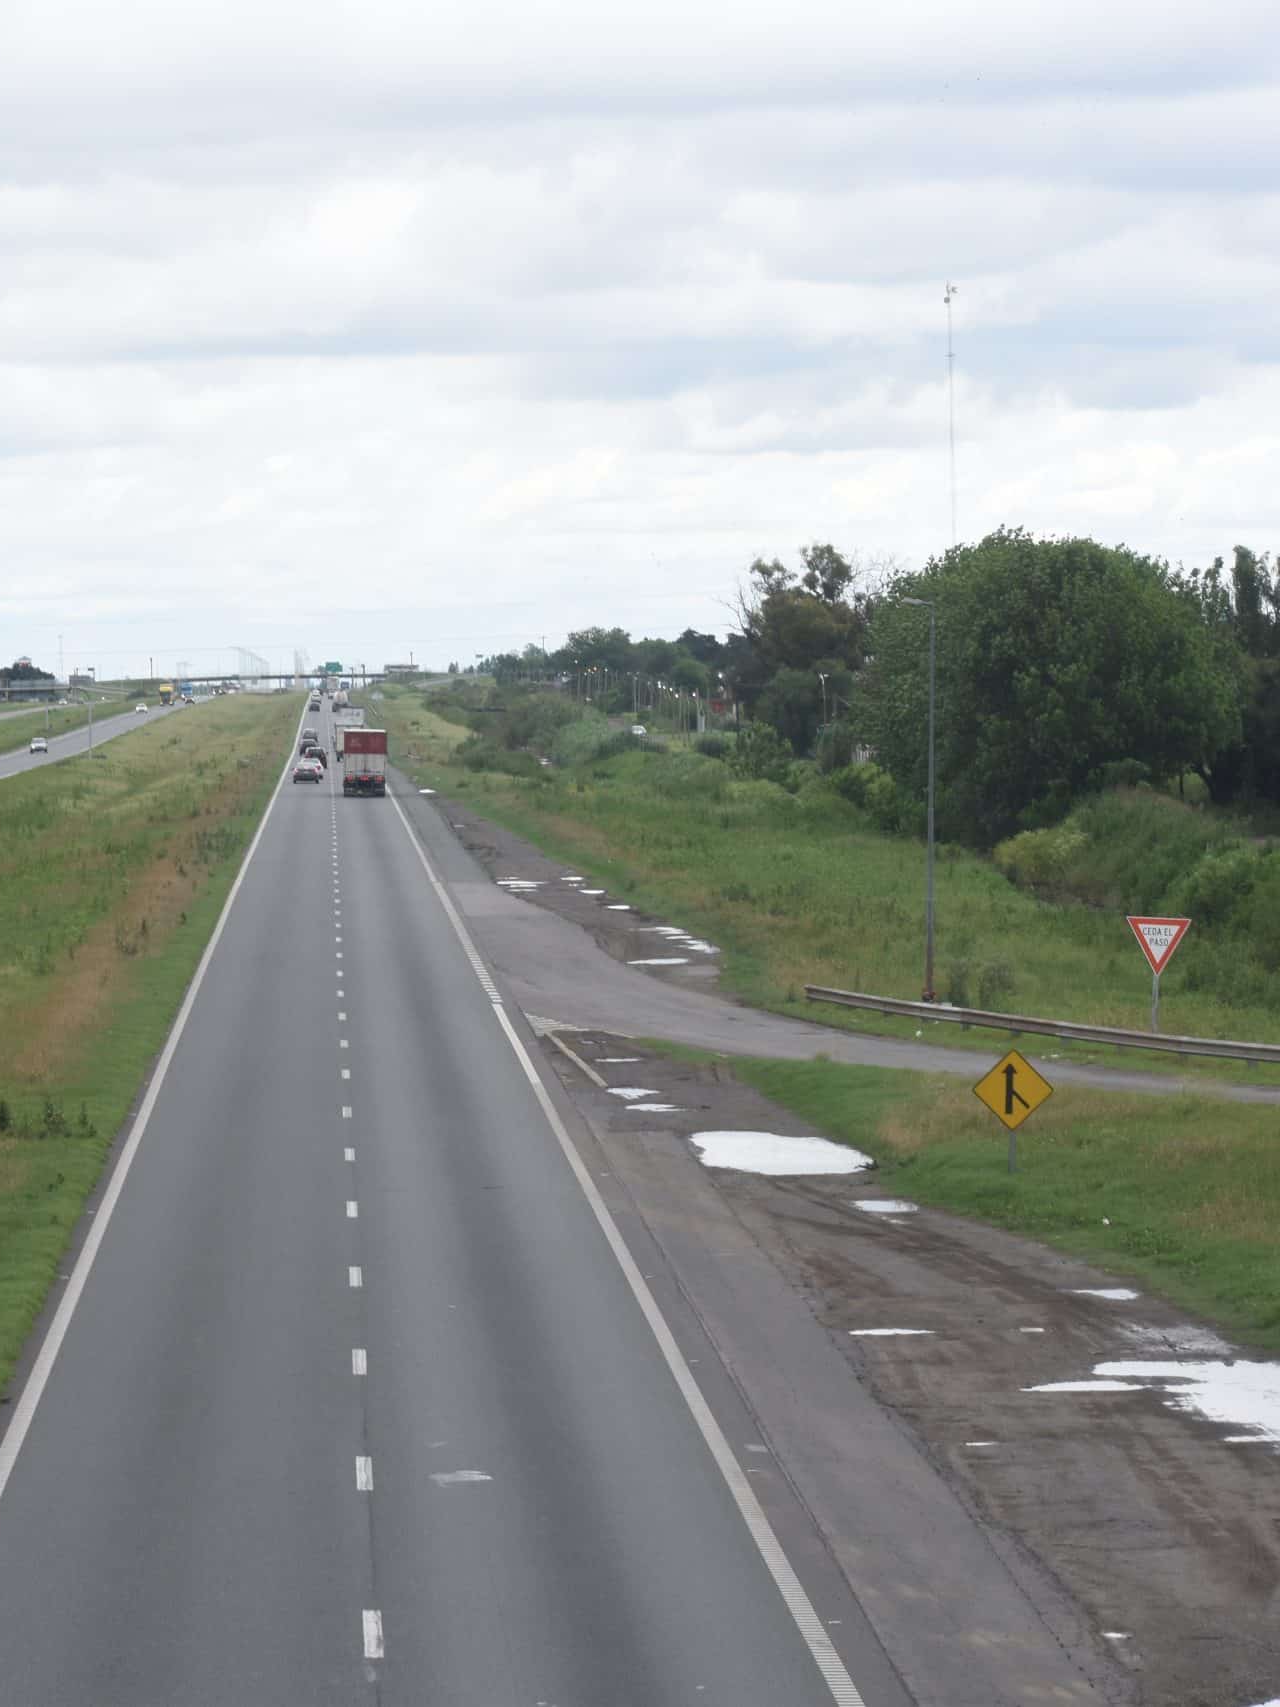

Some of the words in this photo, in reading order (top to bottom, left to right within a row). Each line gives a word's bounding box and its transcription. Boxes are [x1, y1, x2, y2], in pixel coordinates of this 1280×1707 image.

[1143, 927, 1162, 936] CEDA
[1164, 928, 1173, 936] EL
[1150, 938, 1169, 946] PASO
